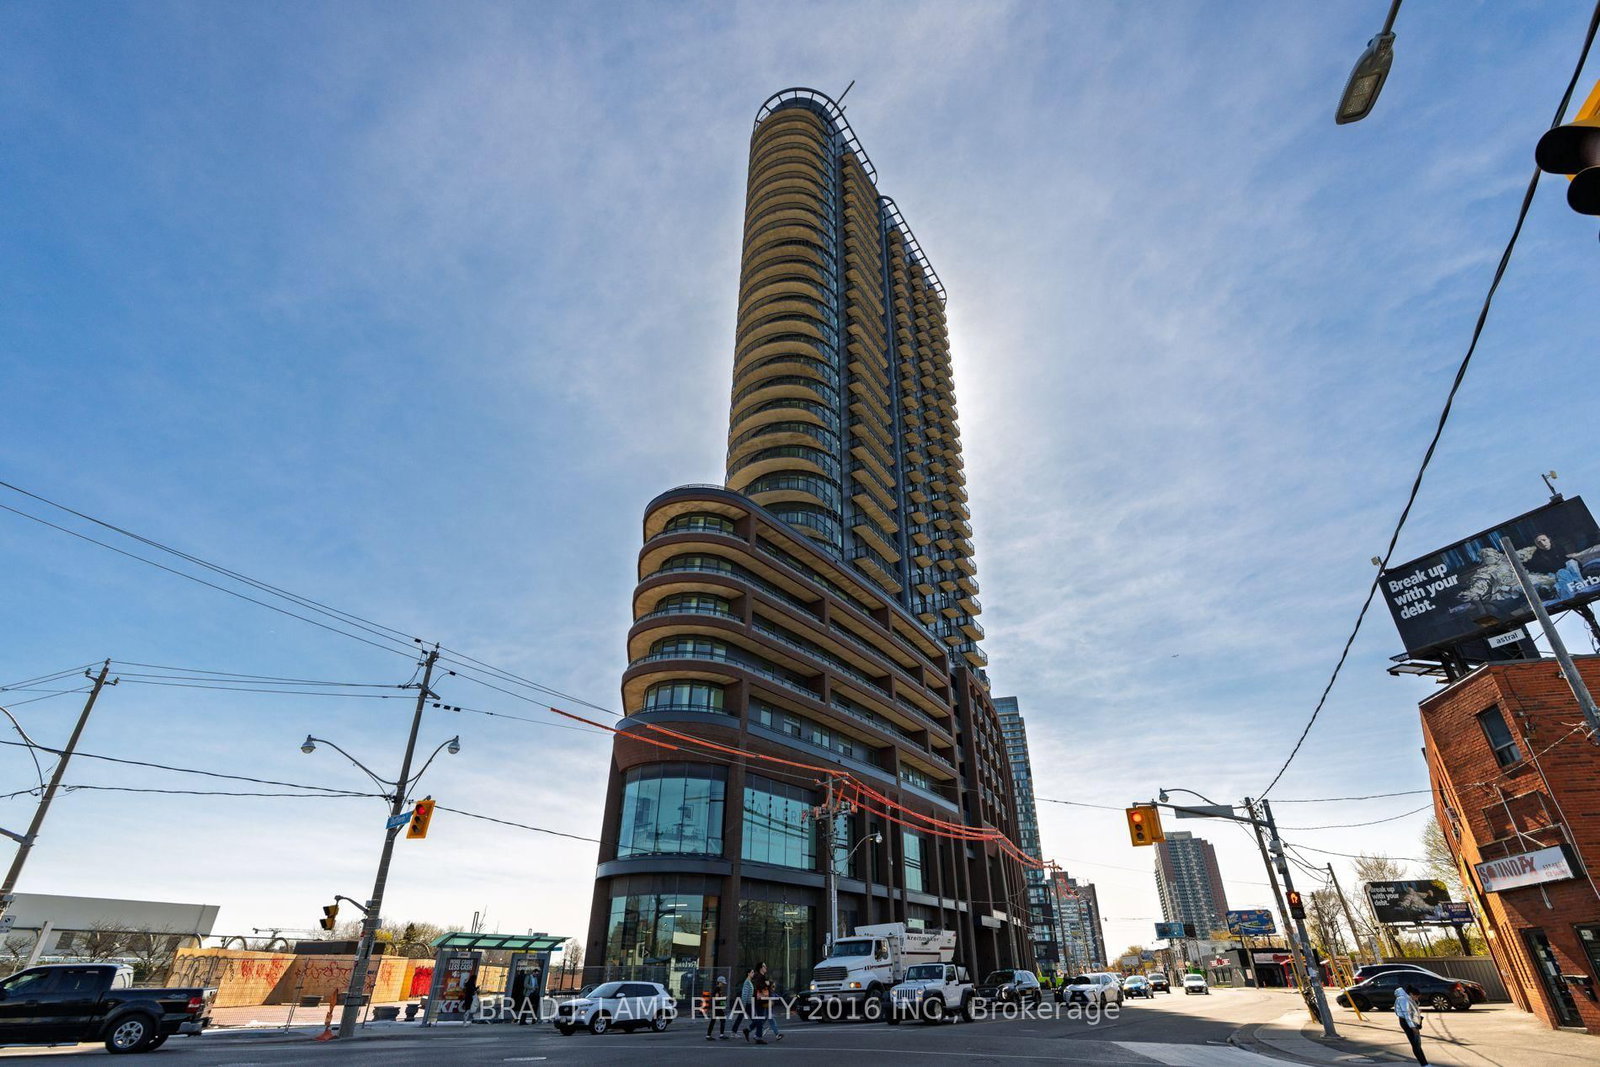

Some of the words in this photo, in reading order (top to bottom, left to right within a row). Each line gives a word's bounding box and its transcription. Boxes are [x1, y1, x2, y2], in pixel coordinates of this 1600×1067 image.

[1388, 570, 1427, 593] Break
[1428, 563, 1447, 578] up
[1567, 575, 1600, 592] Farb
[1394, 586, 1426, 606] with
[1426, 574, 1458, 598] your
[1401, 599, 1436, 619] debt.
[1496, 632, 1518, 644] astral
